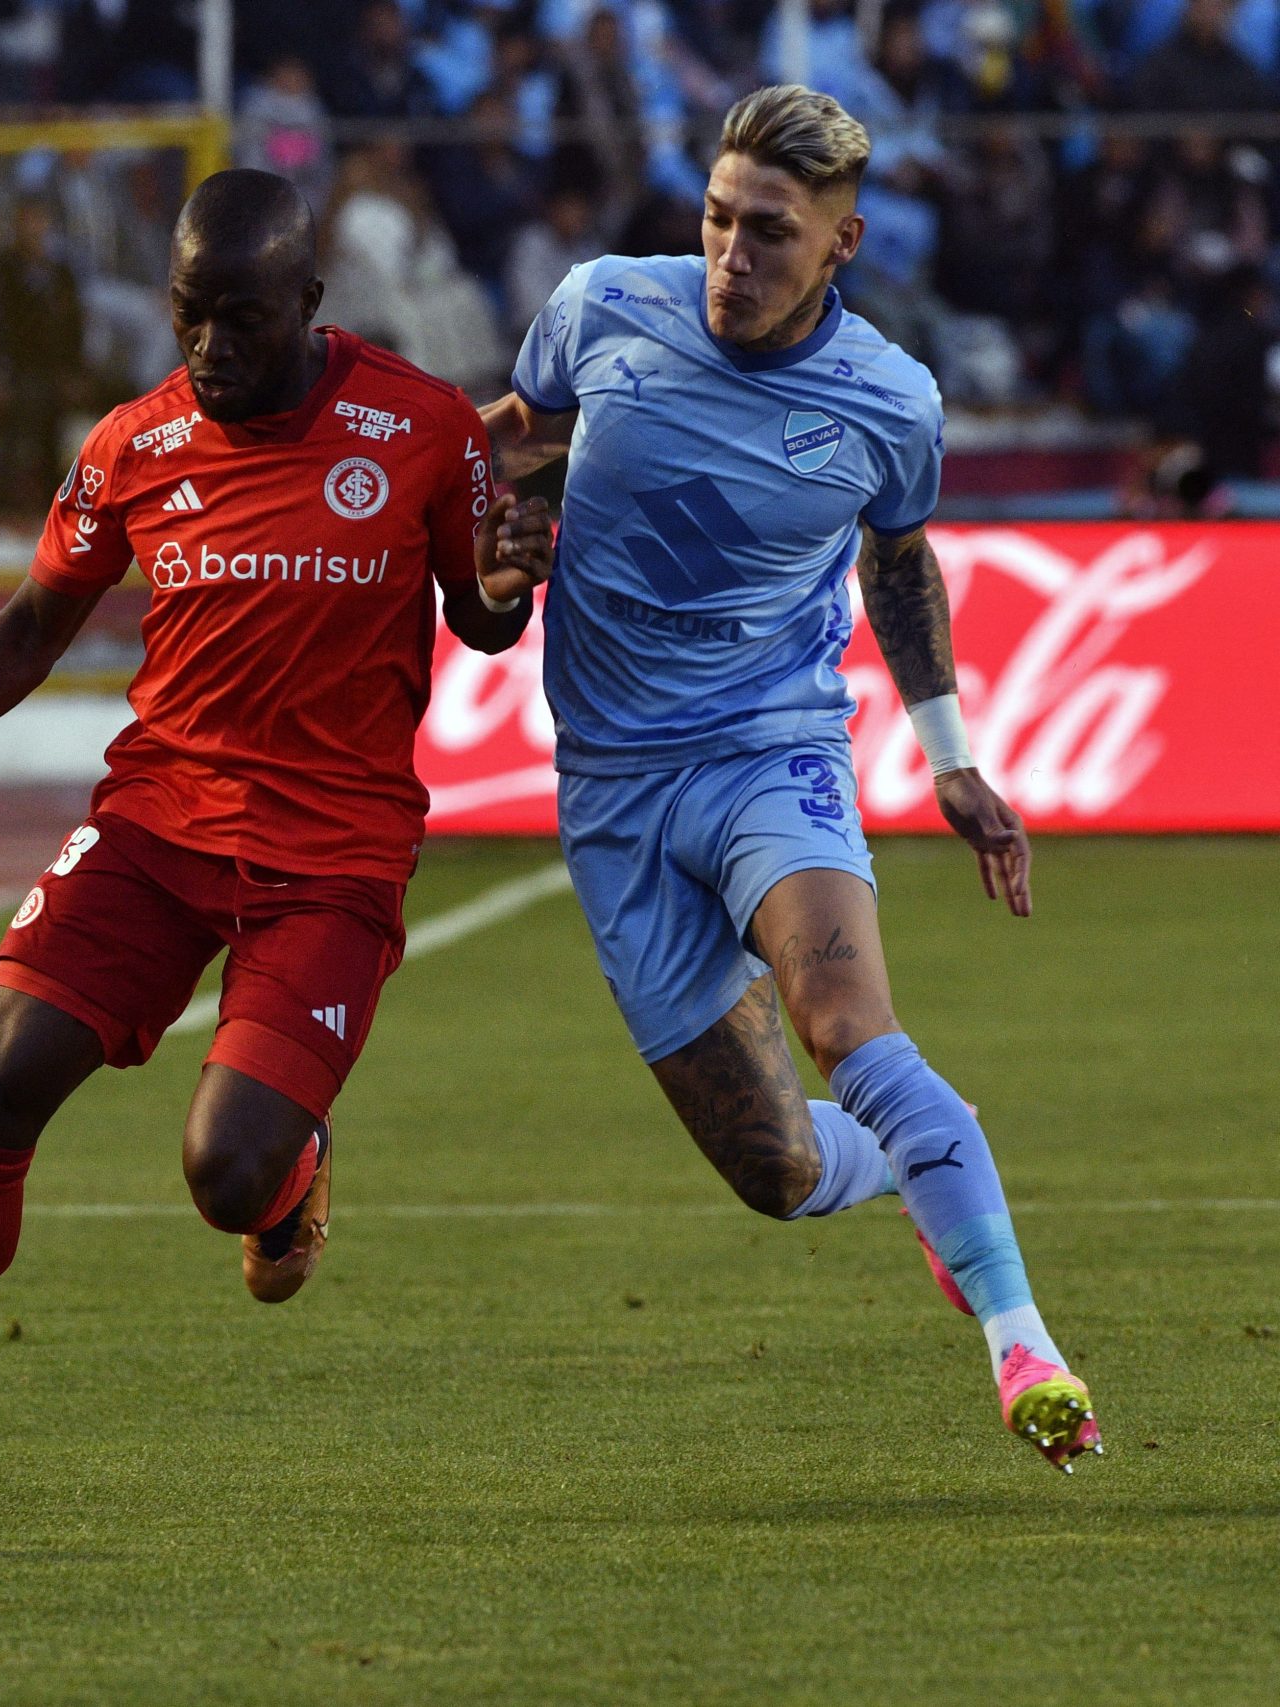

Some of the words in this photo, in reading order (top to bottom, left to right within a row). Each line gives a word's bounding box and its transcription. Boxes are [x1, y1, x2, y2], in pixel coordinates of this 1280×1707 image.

[625, 294, 682, 307] PedidosYa
[854, 376, 906, 412] PedidosYa
[131, 410, 203, 452] ESTRELA
[334, 400, 412, 434] ESTRELA
[358, 421, 396, 442] BET
[163, 427, 193, 454] BET
[786, 425, 840, 452] BOLIVAR
[199, 546, 389, 584] banrisul
[605, 592, 741, 644] SUZUKI
[788, 755, 844, 820] 3
